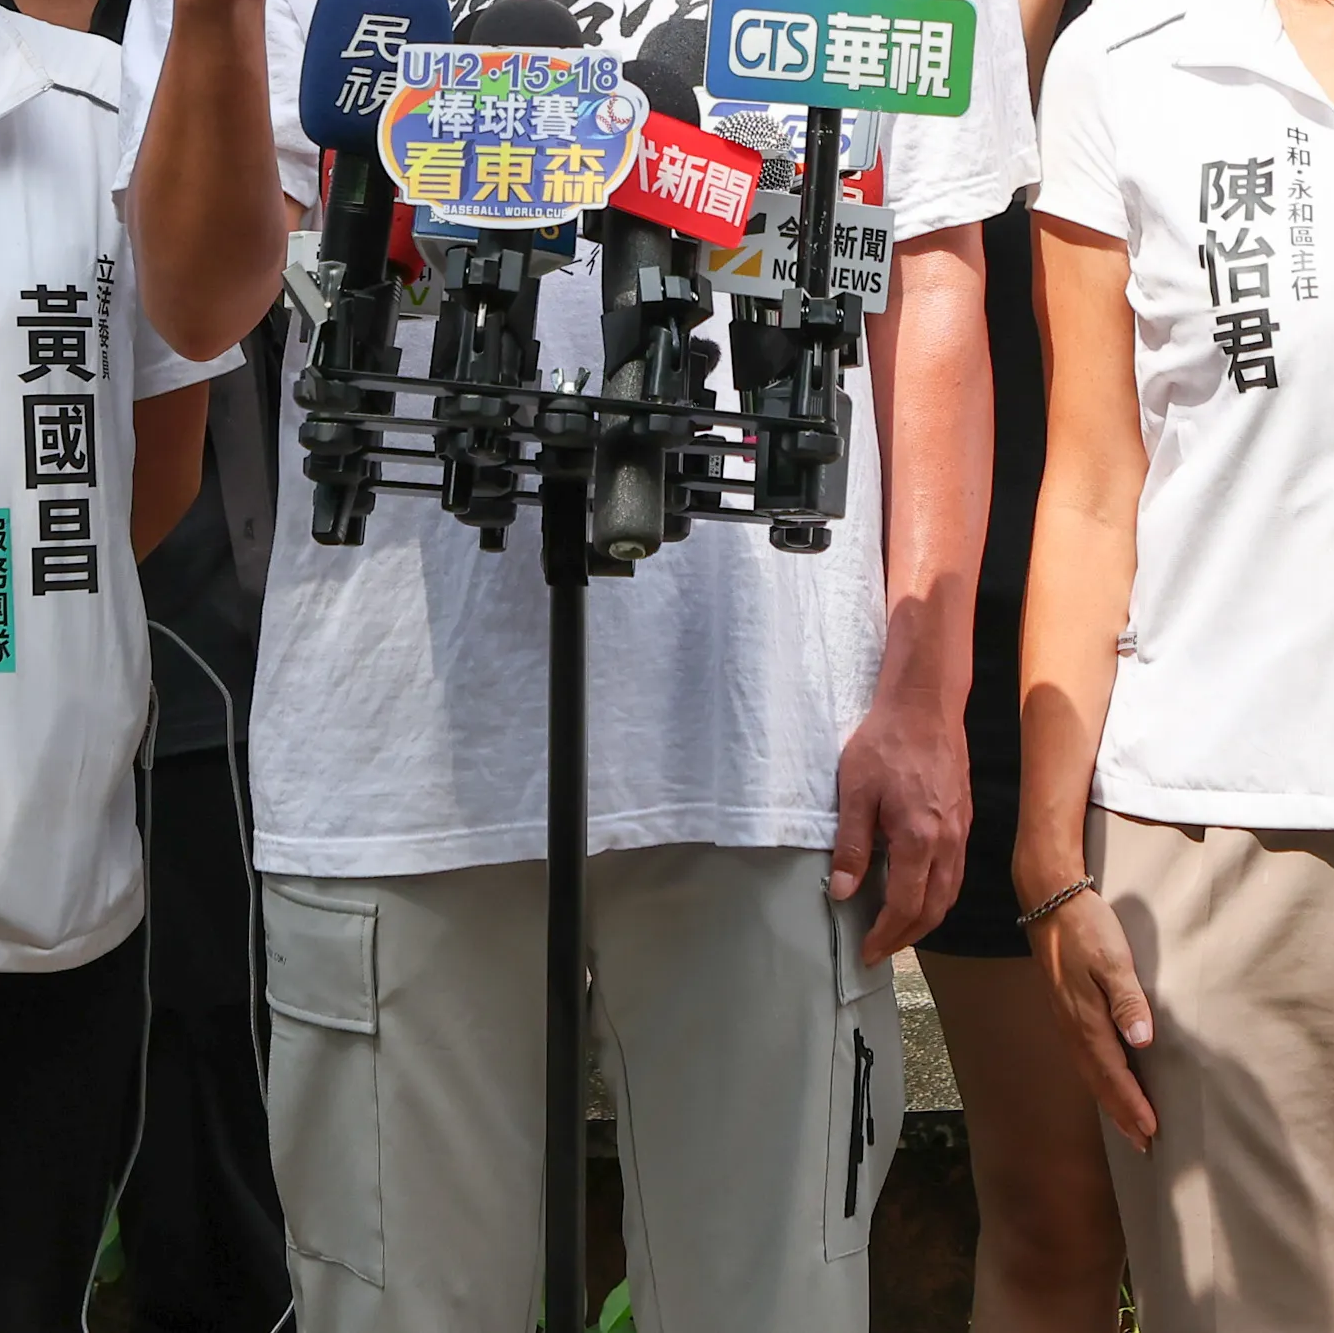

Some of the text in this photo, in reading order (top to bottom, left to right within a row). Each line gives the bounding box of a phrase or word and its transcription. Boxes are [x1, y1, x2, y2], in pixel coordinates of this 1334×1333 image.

[335, 14, 411, 115] 民視
[735, 11, 951, 99] CTS 華視
[427, 90, 579, 143] 棒球賽
[403, 141, 607, 204] 看東森
[443, 204, 501, 216] BASEBALL
[504, 206, 544, 217] WORLD
[777, 216, 888, 264] 今新聞
[1199, 155, 1281, 394] 陳怡君
[95, 253, 116, 381] 立法委員
[17, 284, 99, 597] 黃國昌
